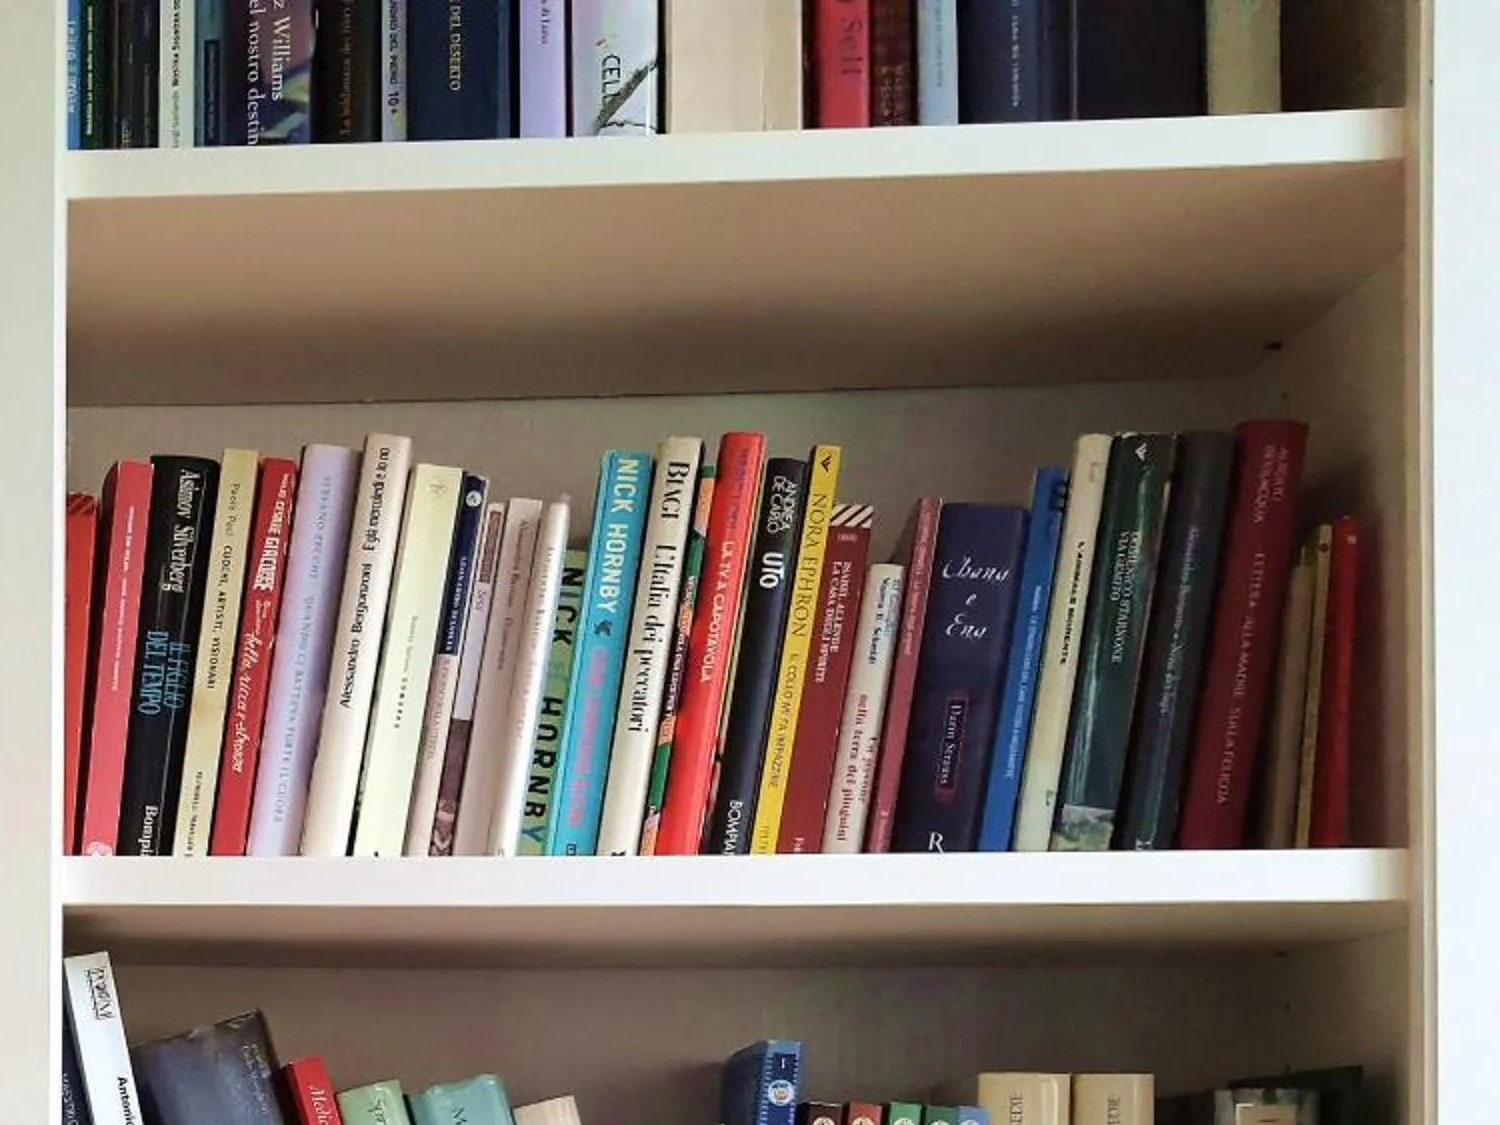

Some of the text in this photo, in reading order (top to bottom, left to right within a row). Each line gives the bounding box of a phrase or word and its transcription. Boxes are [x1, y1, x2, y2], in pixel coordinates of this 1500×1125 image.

[247, 21, 263, 82] nostro
[271, 16, 291, 100] Williams
[449, 33, 462, 91] DESERTO
[661, 462, 689, 518] BIAGI
[162, 469, 199, 592] Asimov Silverberg
[598, 459, 638, 612] NICK HORNBY
[719, 541, 734, 559] LA
[254, 537, 279, 590] GIACOBBE
[718, 562, 730, 576] TV
[758, 550, 784, 588] UTO
[792, 493, 827, 636] NORA EPHRON
[827, 577, 838, 605] CASA
[832, 561, 842, 575] LA
[553, 567, 584, 645] NICK
[699, 593, 725, 681] CAPOTAVOLA
[822, 608, 835, 641] DEGLI
[829, 603, 844, 652] ALLENDE
[1111, 599, 1130, 662] STARNONE
[629, 545, 675, 734] L'Italia dei peccatori
[139, 629, 167, 714] DEL TEMPO
[340, 639, 359, 707] Alessandro
[525, 697, 562, 840] HORNBY
[940, 705, 961, 784] Darin Strauss
[138, 805, 158, 855] Bompi
